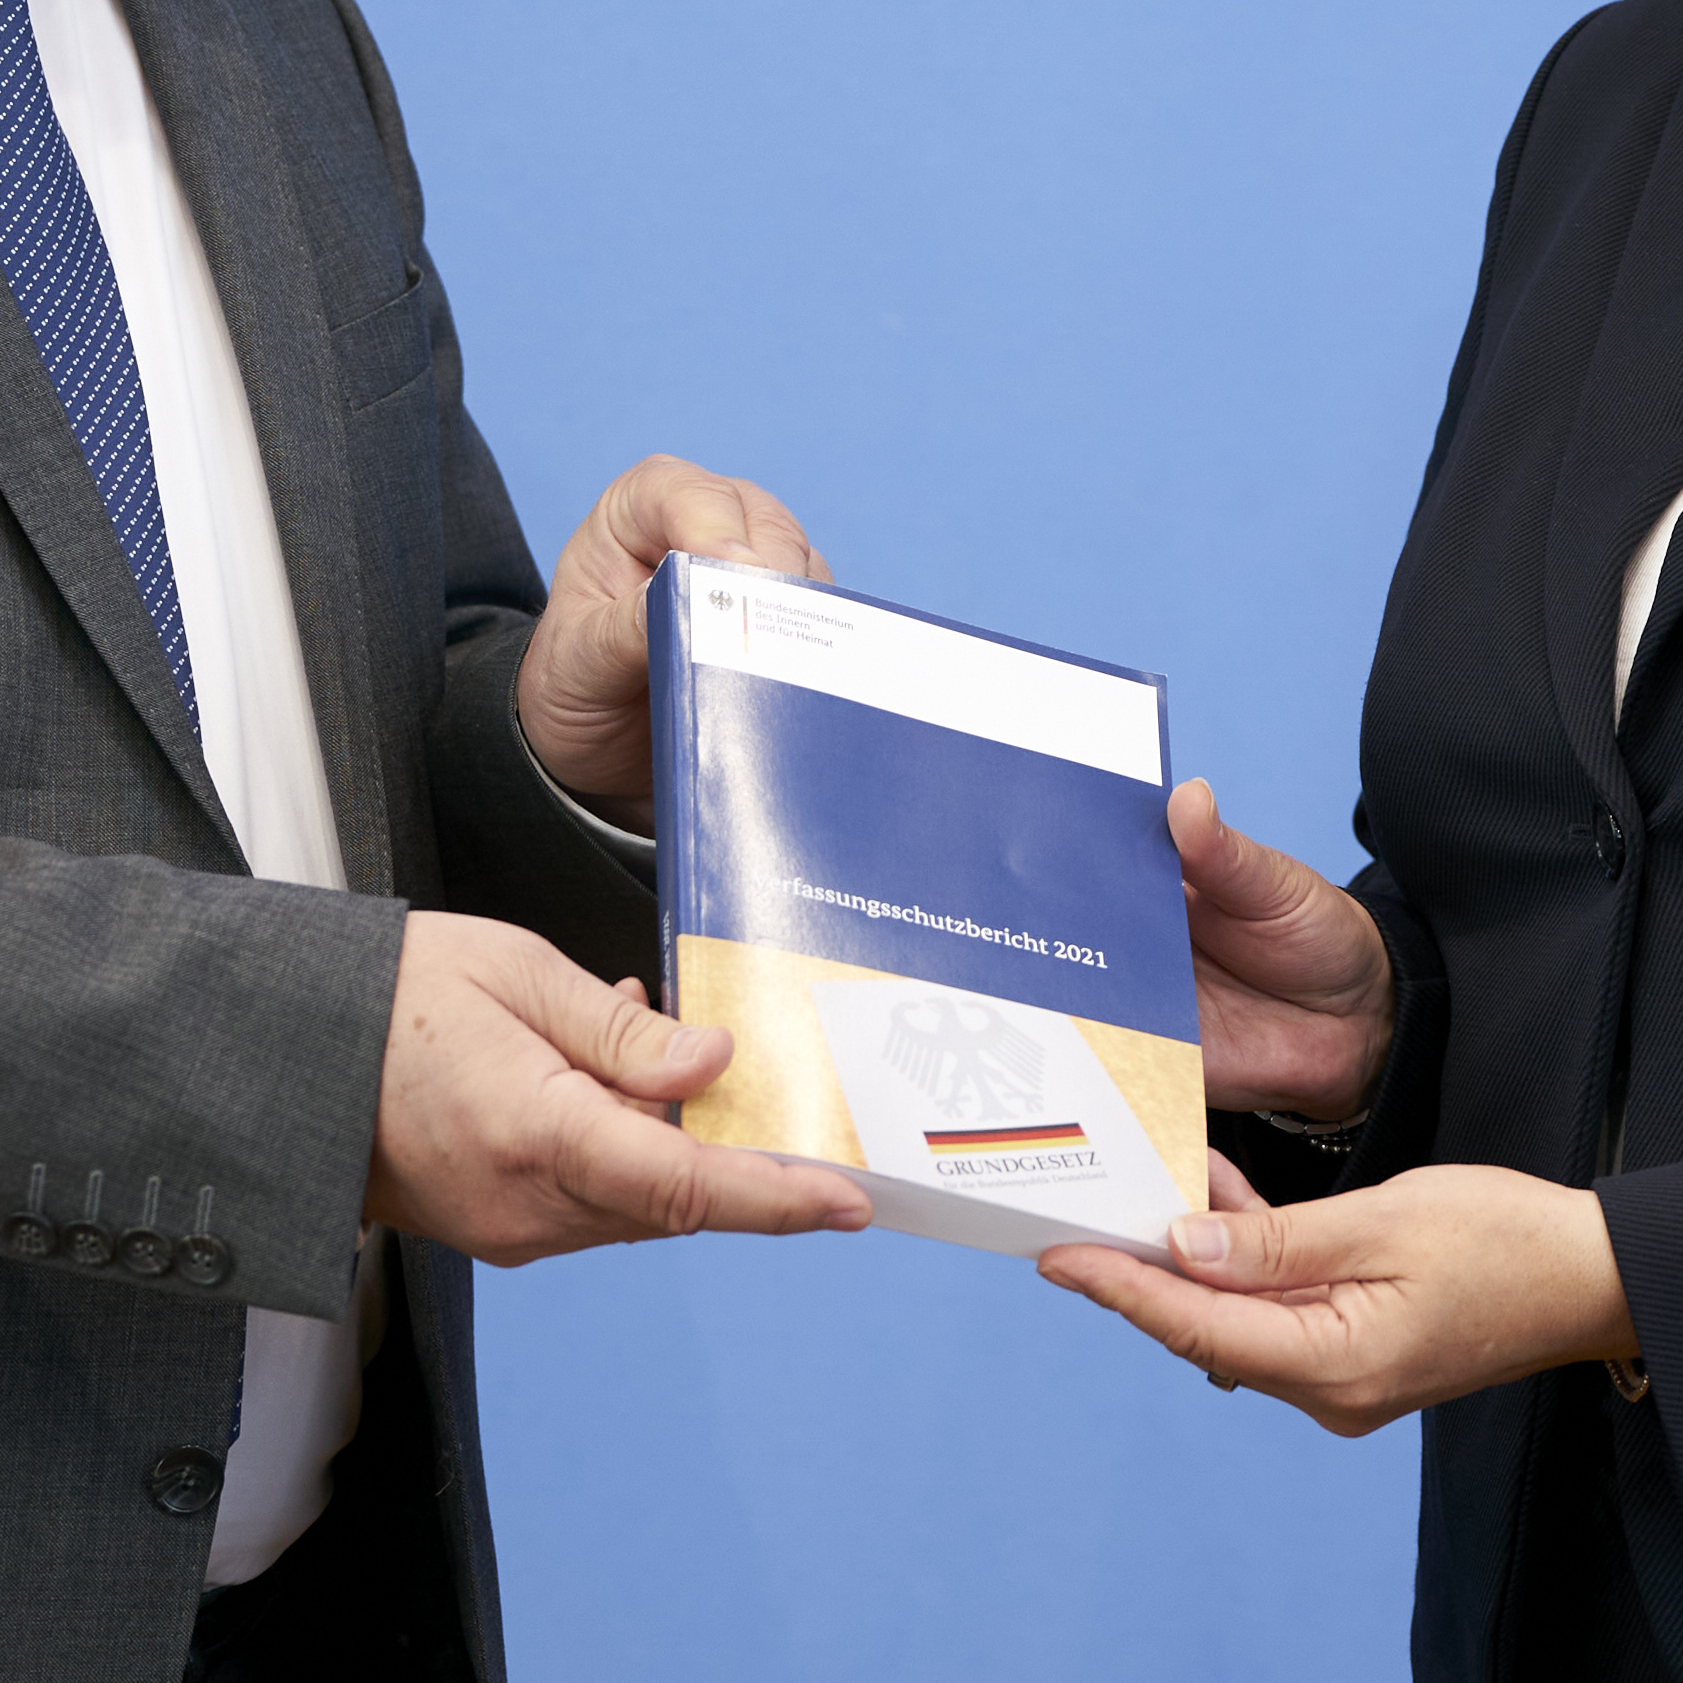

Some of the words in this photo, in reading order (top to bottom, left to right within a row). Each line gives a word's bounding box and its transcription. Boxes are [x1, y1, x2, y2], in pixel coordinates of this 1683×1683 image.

[755, 598, 854, 630] Bundesministerium
[755, 610, 773, 621] des
[776, 613, 810, 630] Innern
[755, 622, 776, 634] und
[778, 625, 794, 637] für
[796, 629, 834, 648] Heimat
[754, 872, 1050, 955] Verfassungsschutzbericht
[1053, 940, 1109, 969] 2021
[936, 1151, 1102, 1176] GRUNDGESETZ
